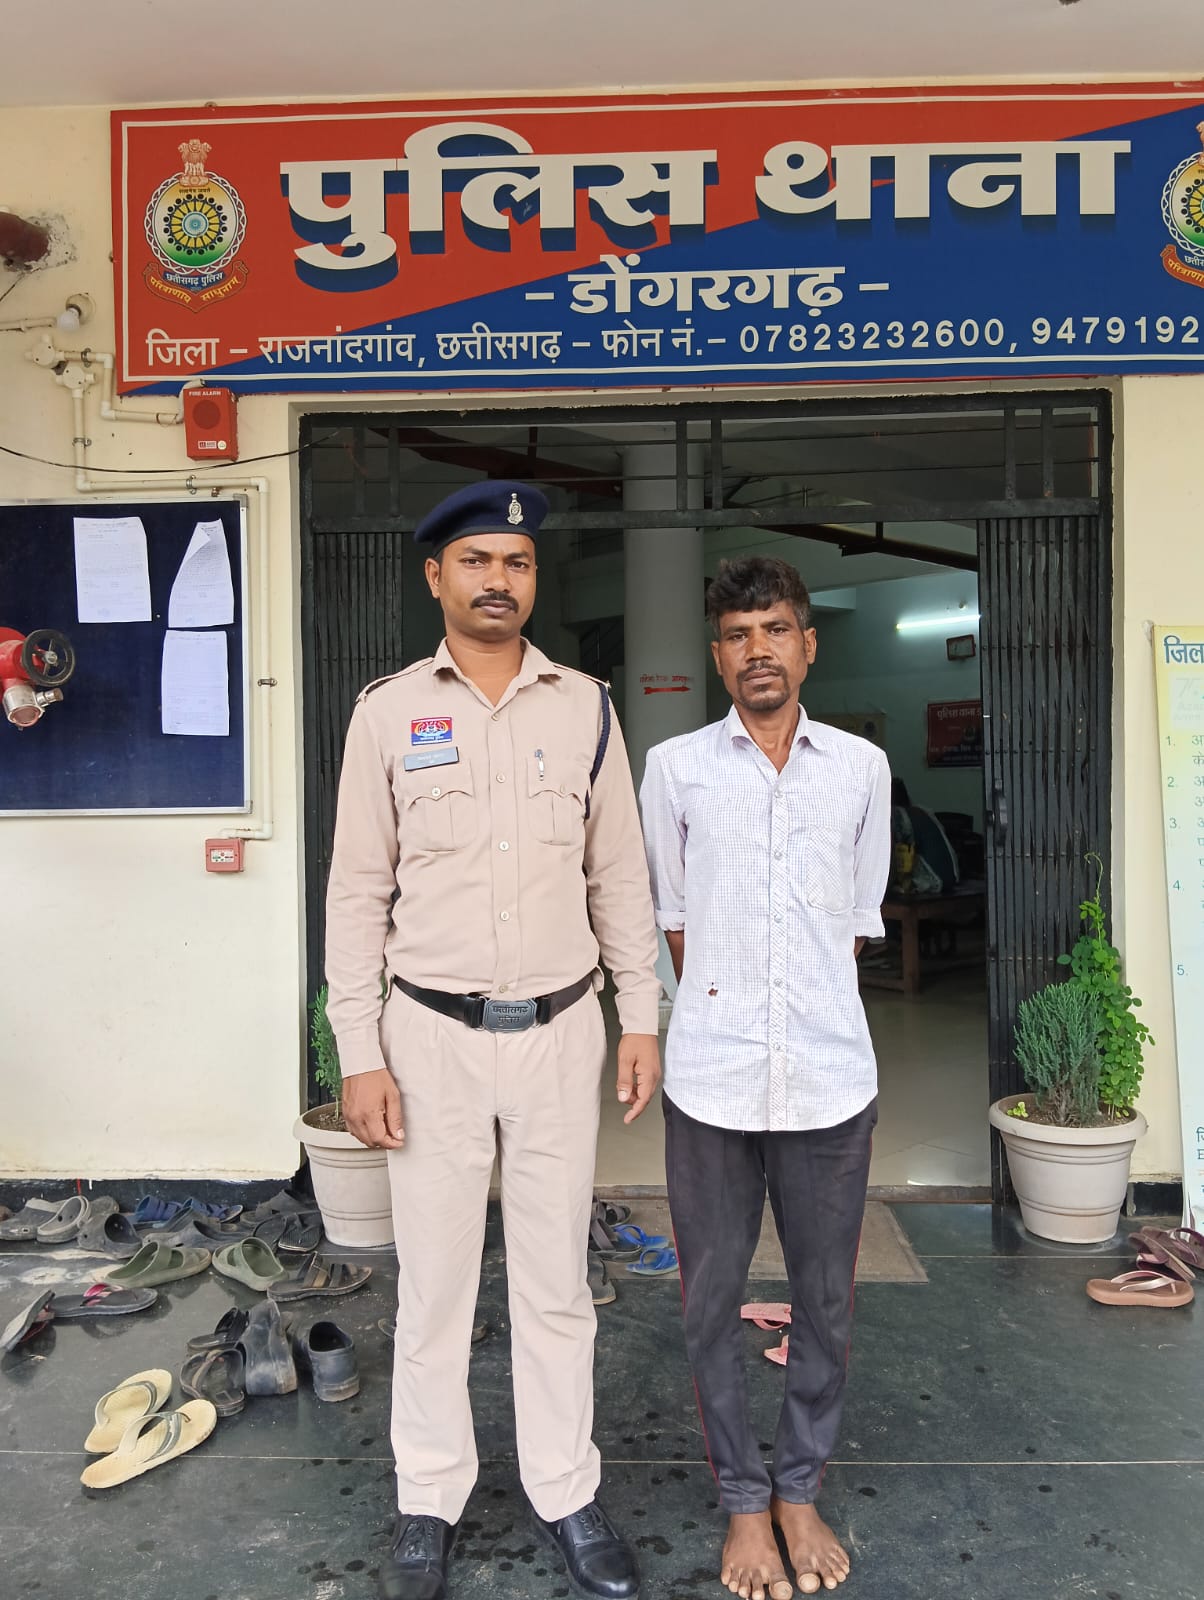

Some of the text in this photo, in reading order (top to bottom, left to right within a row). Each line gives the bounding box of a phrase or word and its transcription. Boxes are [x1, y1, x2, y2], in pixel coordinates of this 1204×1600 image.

[280, 122, 1132, 270] पुलिस थाना
[201, 272, 224, 287] पुलिस
[567, 253, 846, 317] डोंगरगढ़
[145, 328, 220, 366] जिला
[258, 324, 425, 368] राजनांदगांव,
[436, 321, 563, 364] छत्तीसगढ़
[601, 318, 665, 358] फोन
[739, 318, 1018, 354] 07823232600,
[1031, 315, 1200, 345] 9479192
